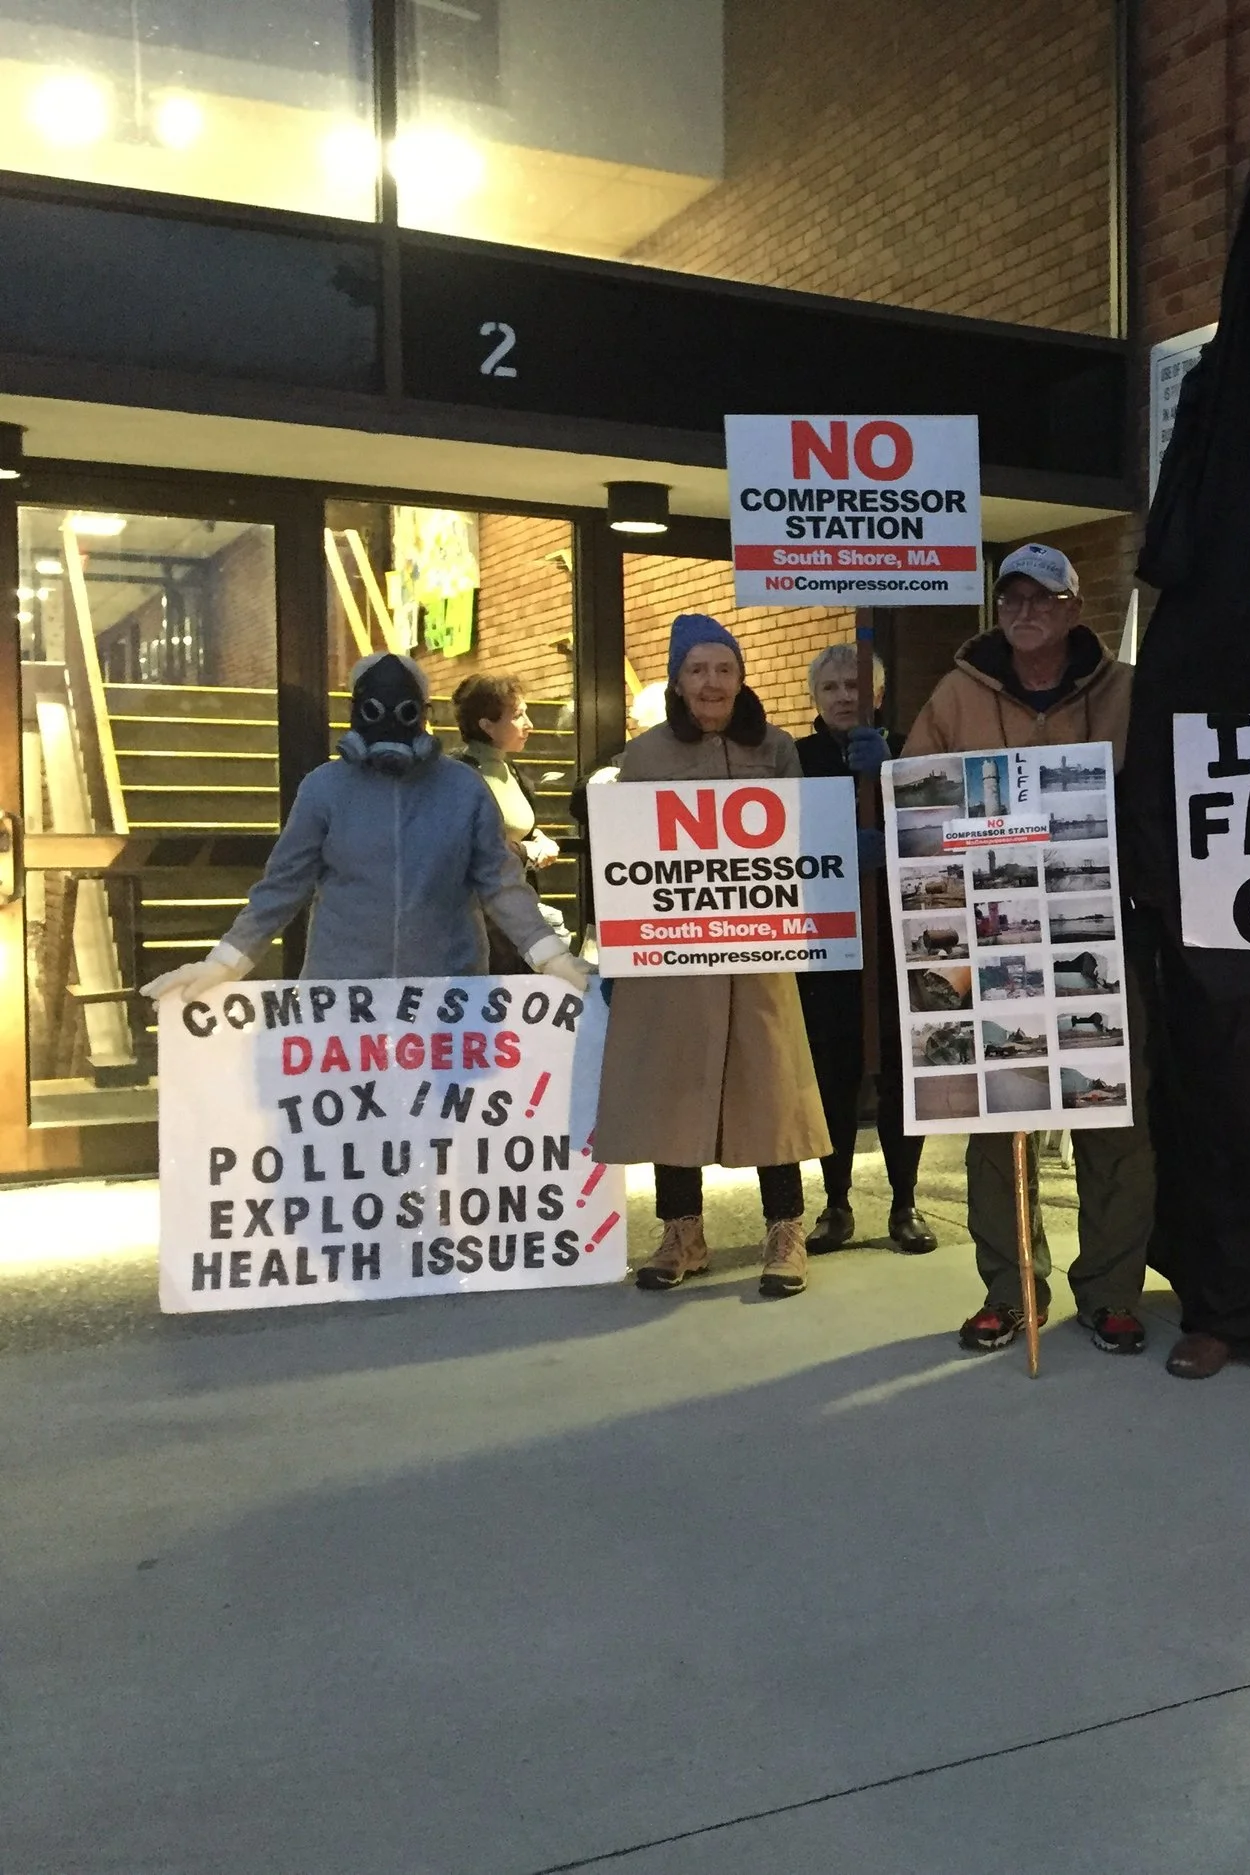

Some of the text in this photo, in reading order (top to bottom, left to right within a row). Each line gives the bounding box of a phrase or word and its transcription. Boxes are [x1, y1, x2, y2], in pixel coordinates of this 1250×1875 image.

[480, 321, 517, 378] 2
[791, 420, 913, 481] NO
[740, 488, 967, 513] COMPRESSOR
[785, 516, 923, 540] STATION
[773, 549, 940, 569] South Shore, MA
[765, 576, 948, 594] NOCompressor.com
[1016, 753, 1029, 802] LIFE
[655, 786, 786, 851] NO
[945, 825, 1047, 840] COMPRESSOR STATION
[987, 819, 1004, 828] NO
[604, 854, 844, 886] COMPRESSOR
[653, 884, 798, 912] STATION
[640, 917, 818, 940] South Shore, MA
[632, 948, 827, 967] NOCompressor.com
[182, 985, 585, 1038] COMPRESSOR
[282, 1030, 521, 1076] DANGERS
[192, 1242, 380, 1292] HEALTH
